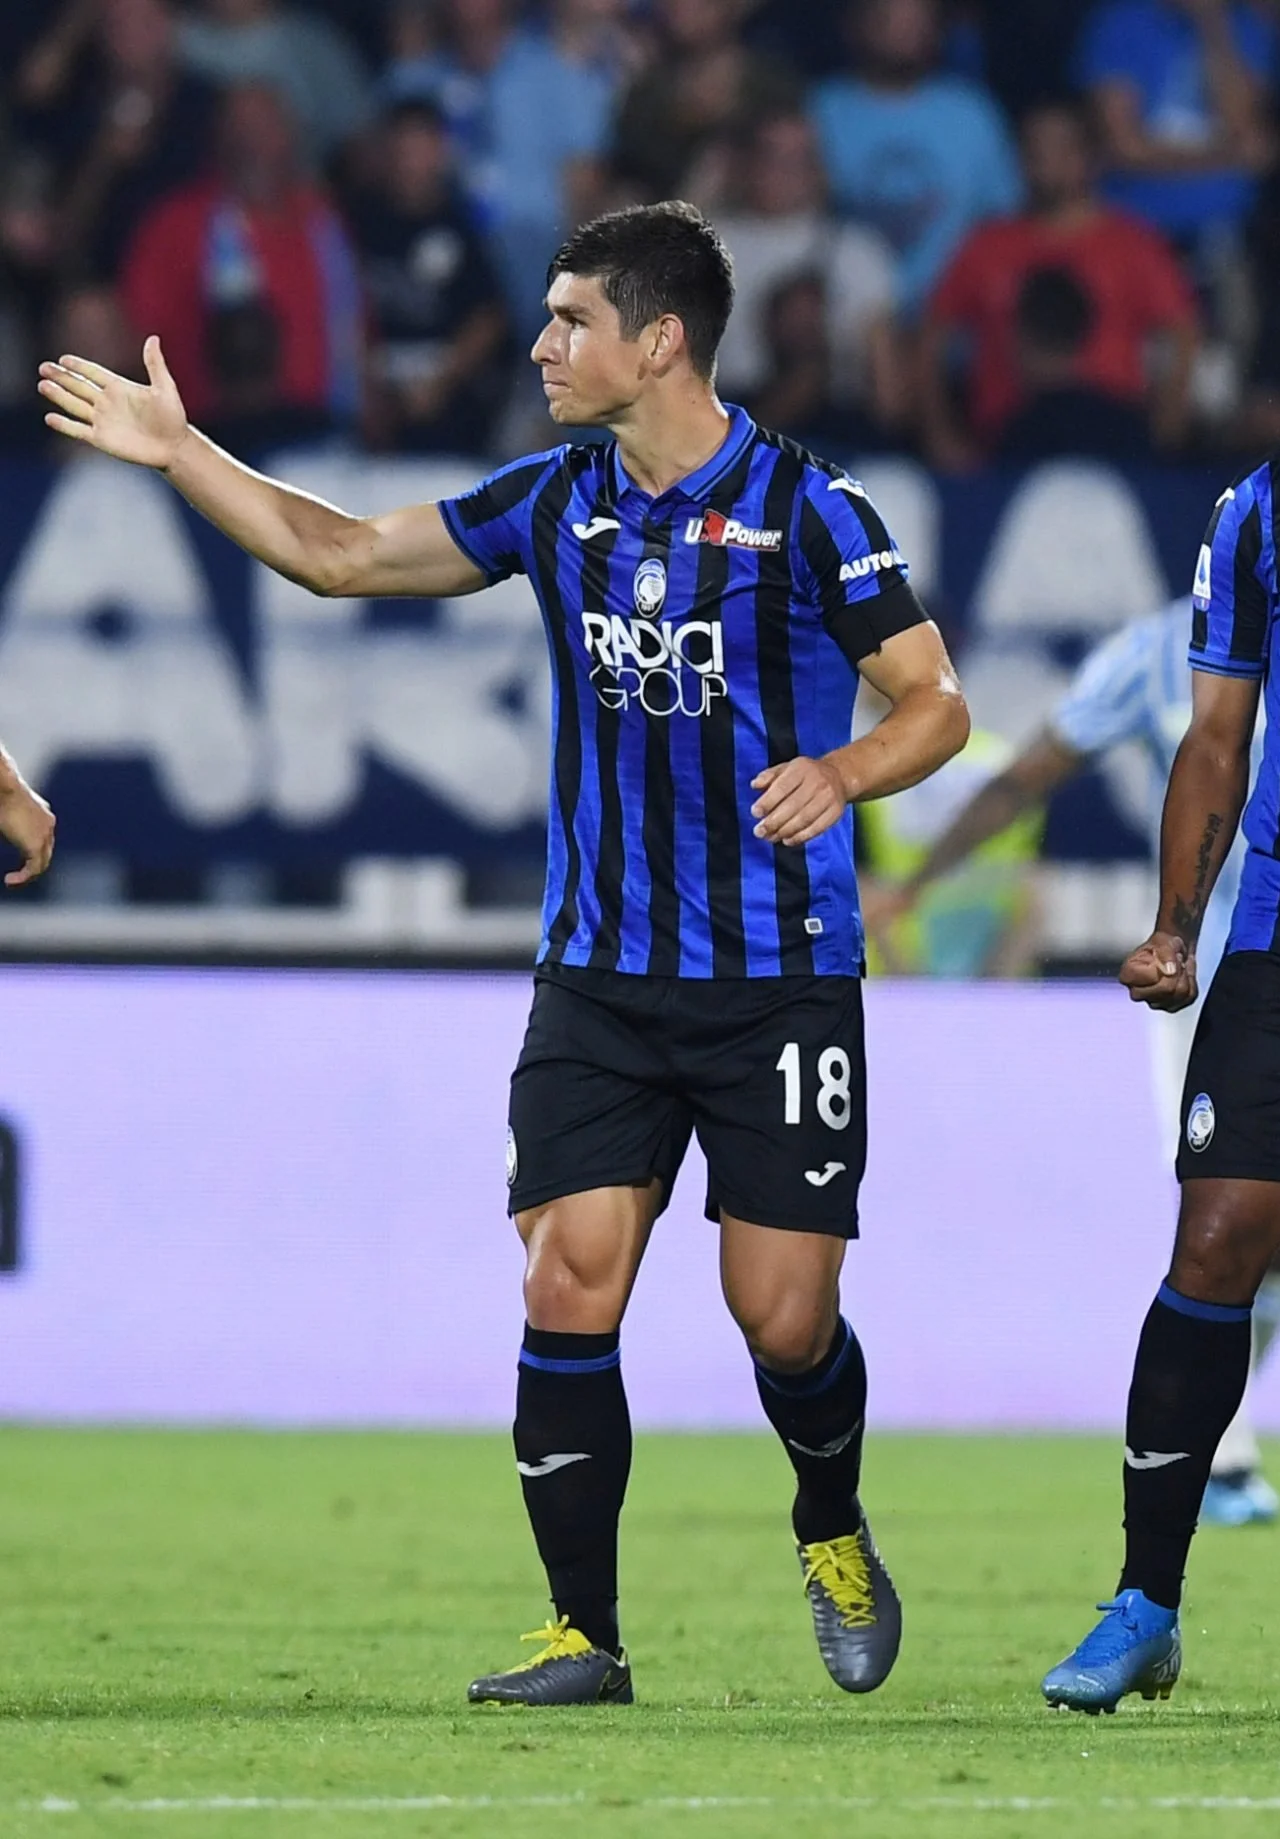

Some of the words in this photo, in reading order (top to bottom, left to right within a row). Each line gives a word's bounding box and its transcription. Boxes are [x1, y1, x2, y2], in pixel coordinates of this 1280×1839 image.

[721, 519, 781, 548] Power
[839, 549, 908, 581] AUTO
[582, 612, 724, 674] RADICI
[588, 665, 728, 717] GROUP
[776, 1042, 851, 1131] 18
